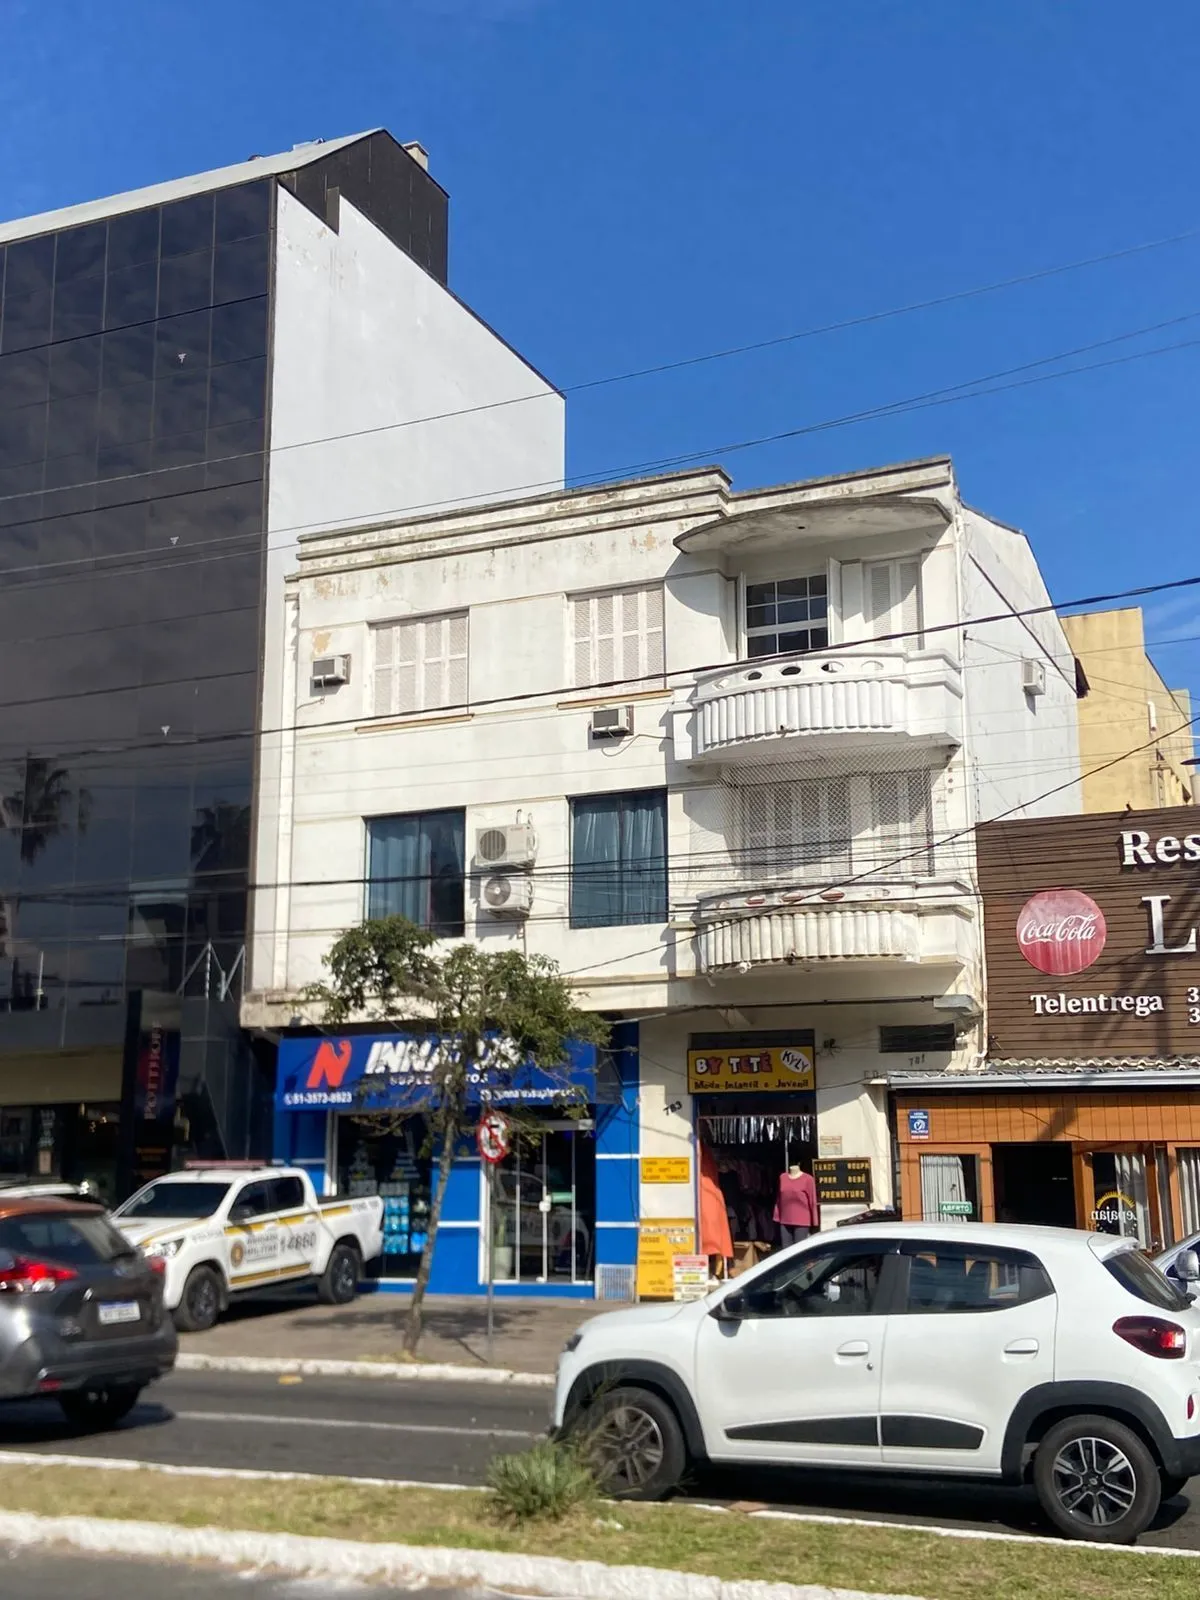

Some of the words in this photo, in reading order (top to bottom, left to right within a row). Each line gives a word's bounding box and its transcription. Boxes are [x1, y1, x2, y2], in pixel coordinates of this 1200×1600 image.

[1120, 830, 1200, 866] Res
[1141, 894, 1197, 955] L
[1030, 993, 1165, 1017] Telentrega
[695, 1057, 723, 1075] BY
[782, 1049, 809, 1073] KYLY
[942, 1204, 970, 1212] ABERTO
